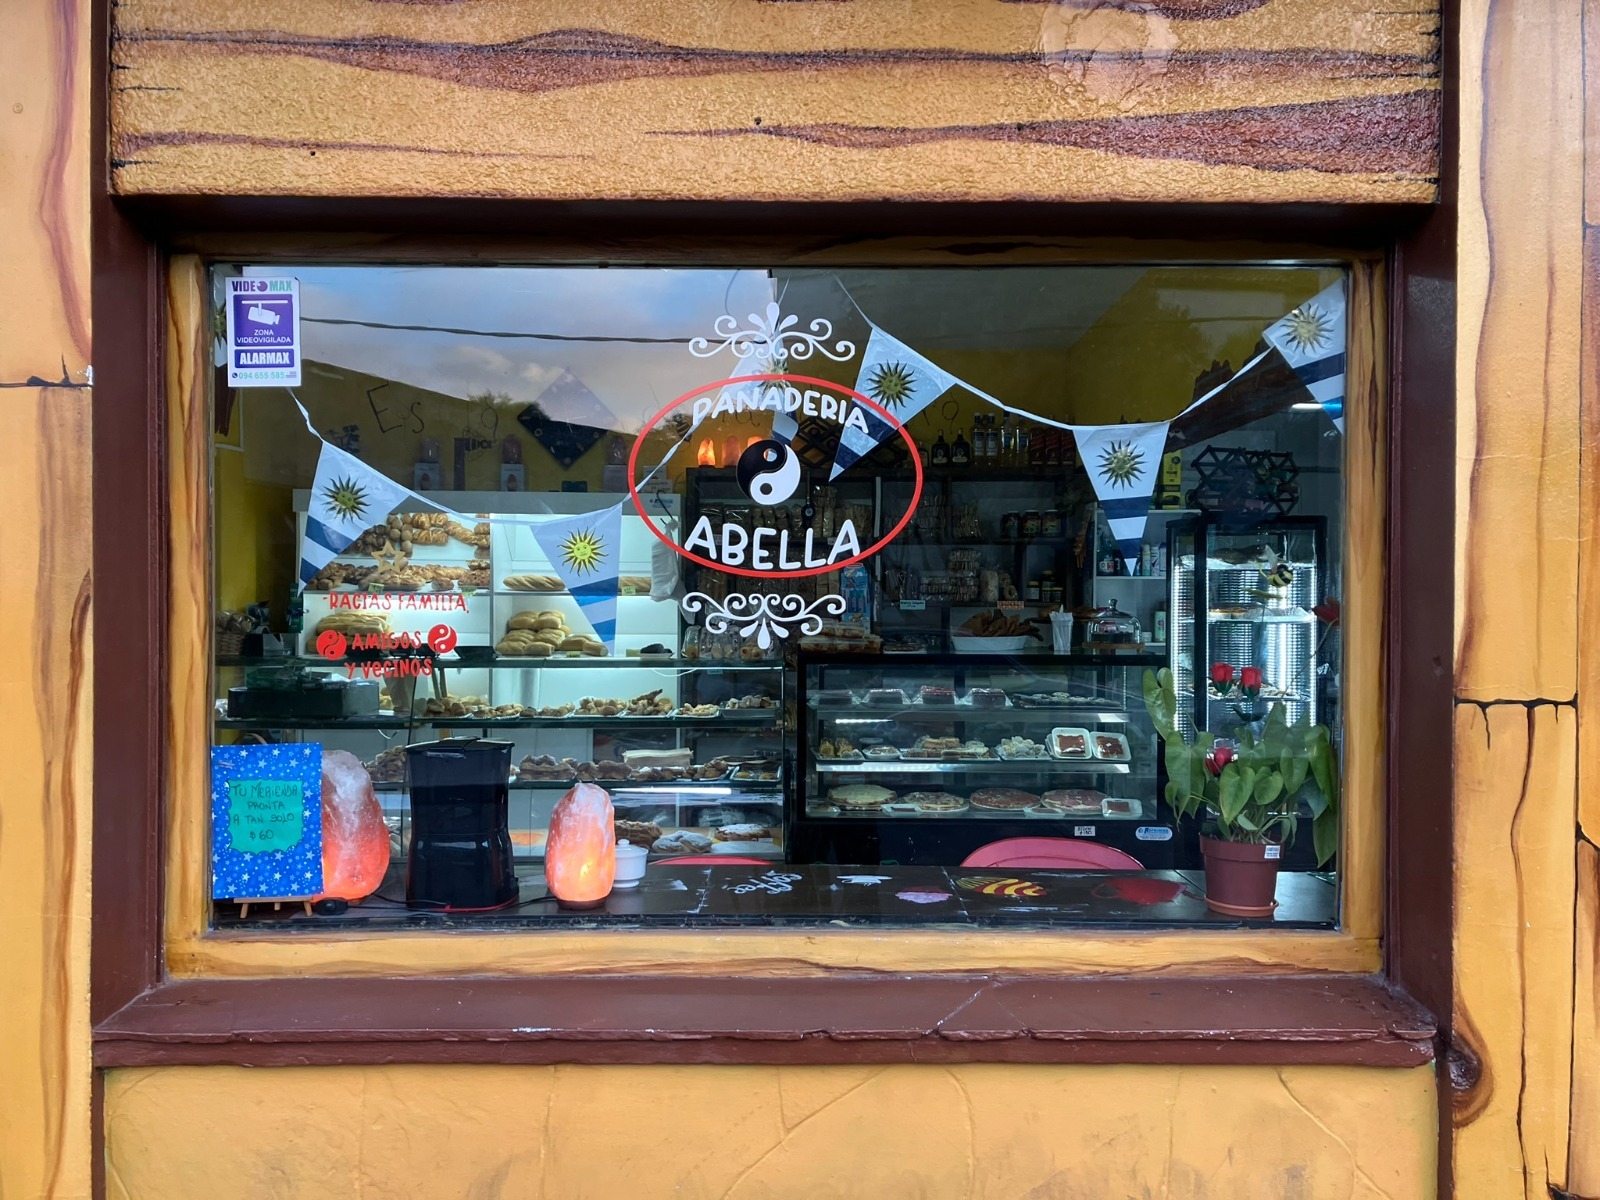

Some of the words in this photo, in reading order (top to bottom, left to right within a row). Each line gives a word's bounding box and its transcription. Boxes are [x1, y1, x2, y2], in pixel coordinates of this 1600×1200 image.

[236, 336, 292, 344] VIDEOVIGILADA
[239, 352, 291, 365] ALARMAX
[692, 386, 870, 434] PANADERIA
[684, 515, 861, 570] ABELLA
[322, 592, 393, 610] RACIAS
[351, 630, 423, 651] AMIGOS
[230, 784, 247, 798] TU
[250, 781, 298, 799] MERIENDA
[247, 800, 286, 811] PRONTA
[233, 813, 240, 826] A
[244, 814, 264, 824] TAN
[270, 812, 295, 824] SOLO
